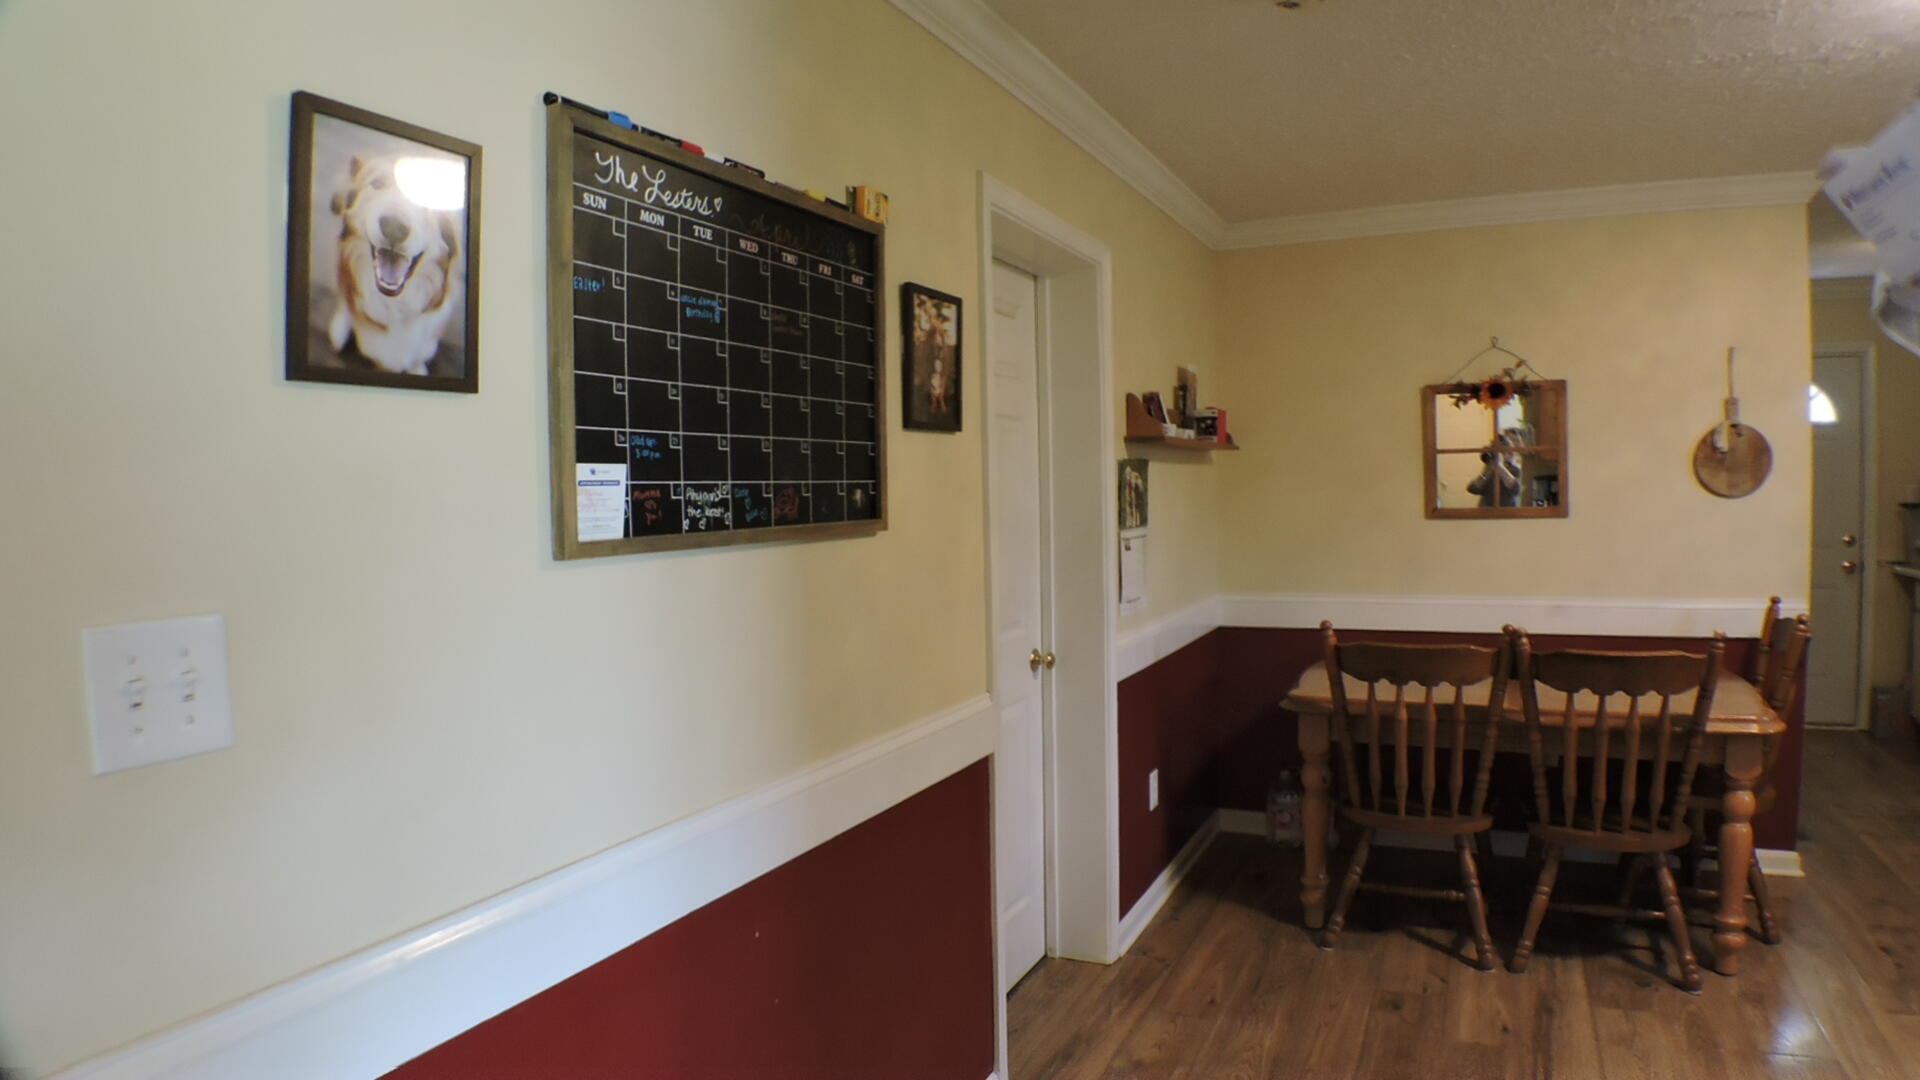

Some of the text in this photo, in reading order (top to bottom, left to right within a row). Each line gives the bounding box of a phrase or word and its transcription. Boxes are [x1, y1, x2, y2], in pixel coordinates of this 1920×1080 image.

[594, 152, 638, 192] The
[582, 192, 864, 286] SUN MON TUE WED THU FRI SAT
[687, 504, 702, 518] the
